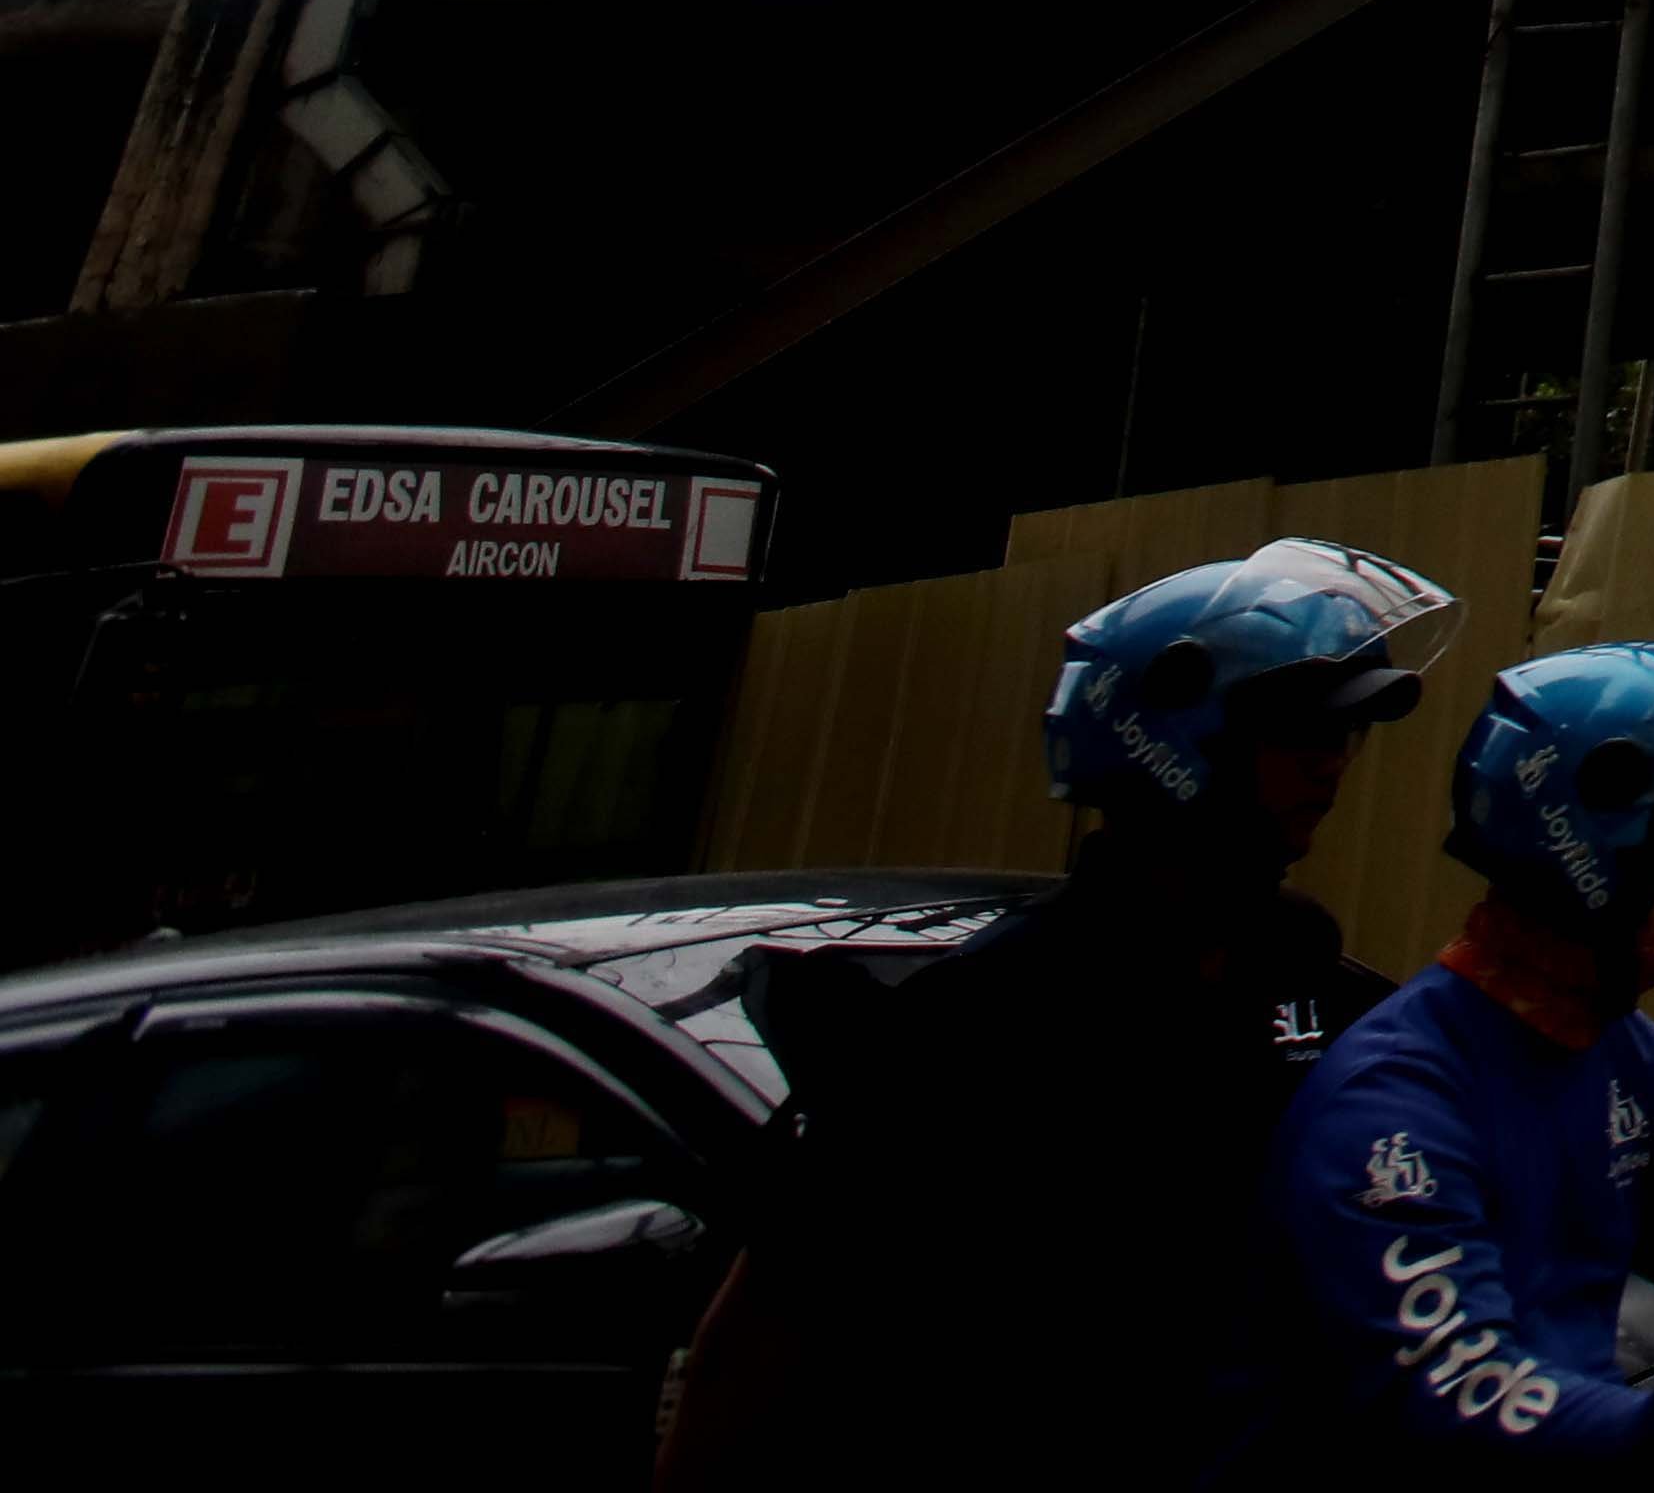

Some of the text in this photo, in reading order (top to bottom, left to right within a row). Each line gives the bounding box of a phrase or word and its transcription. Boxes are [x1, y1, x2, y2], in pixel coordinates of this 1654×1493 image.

[191, 481, 265, 555] E
[318, 468, 673, 530] EDSA CAROUSEL
[446, 539, 561, 577] AIRCON
